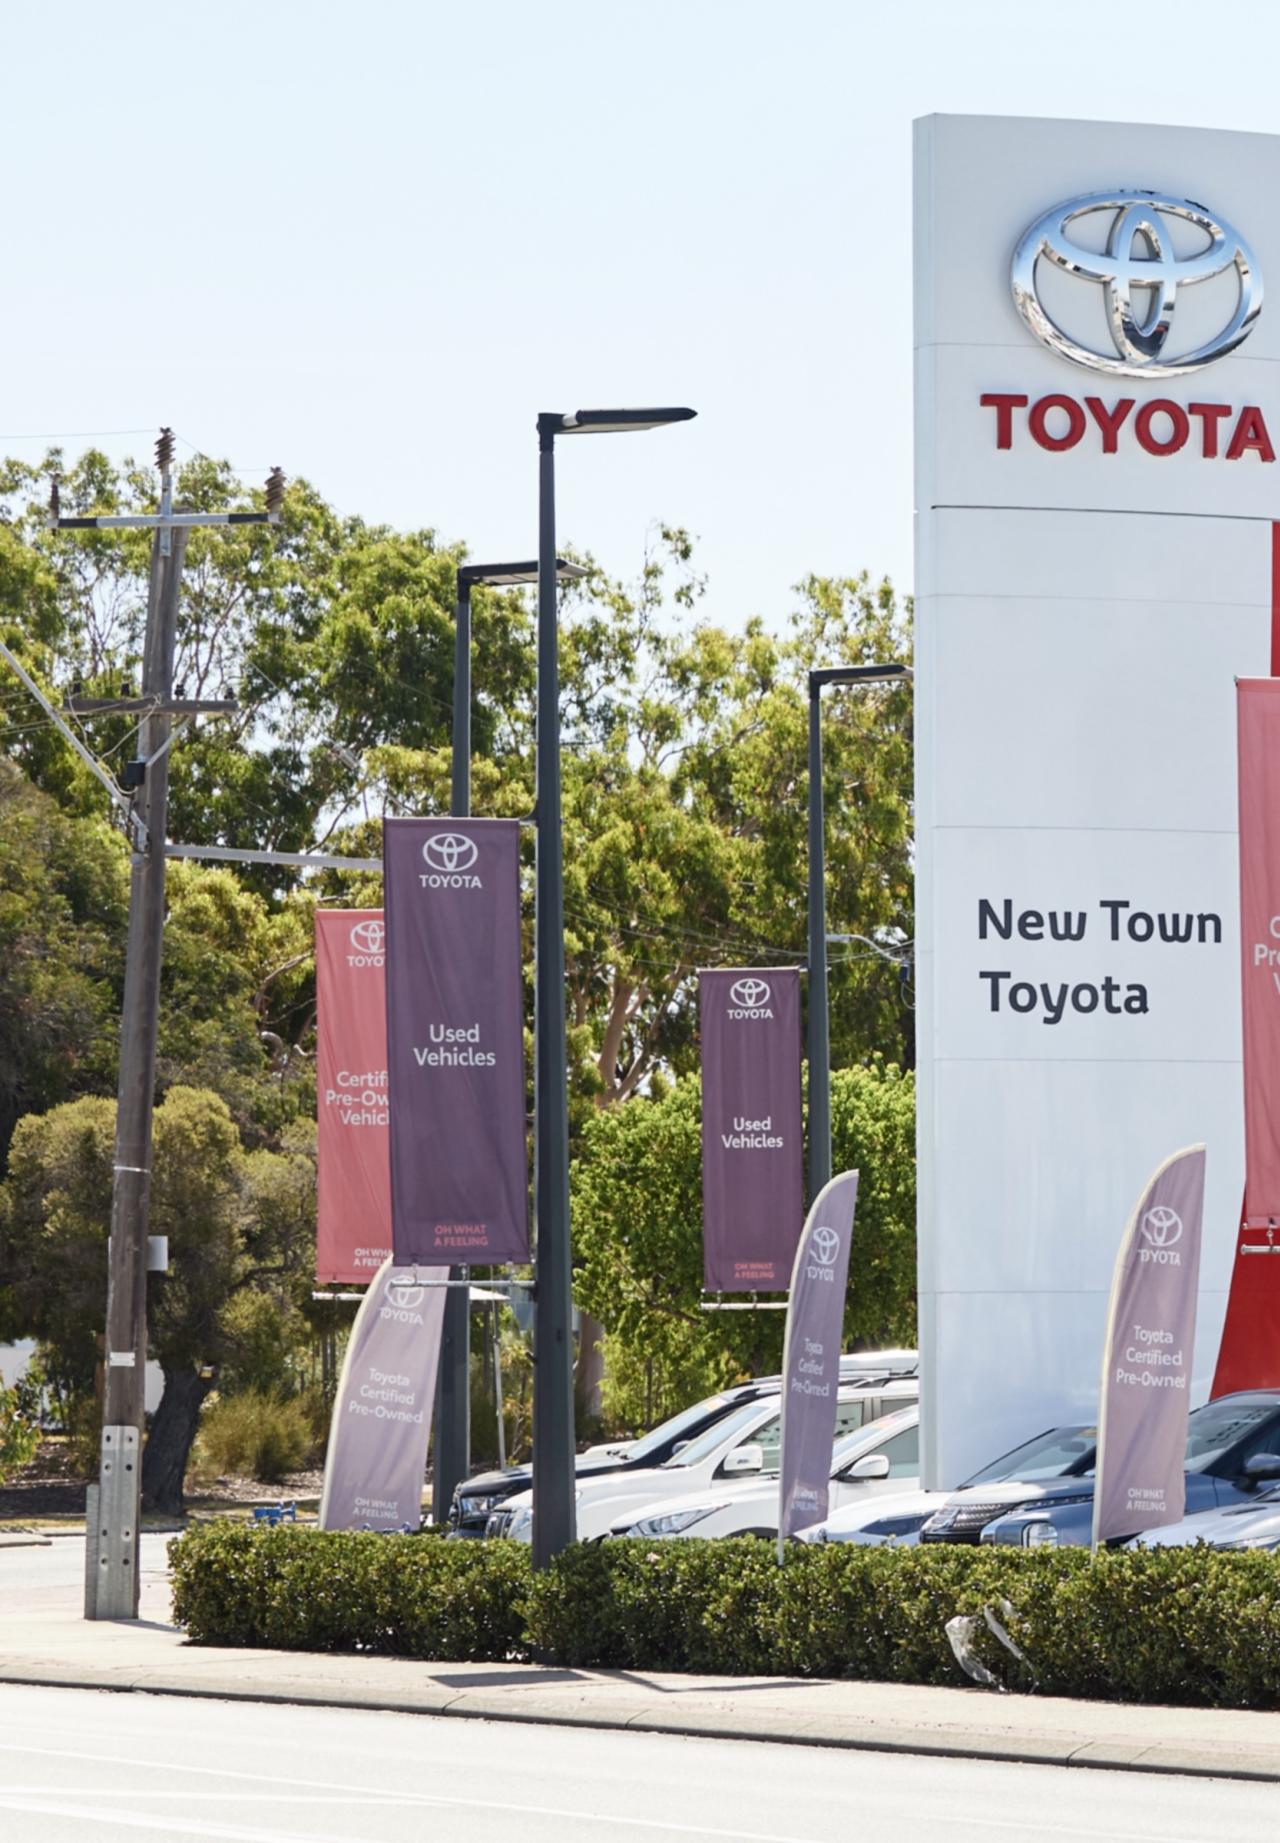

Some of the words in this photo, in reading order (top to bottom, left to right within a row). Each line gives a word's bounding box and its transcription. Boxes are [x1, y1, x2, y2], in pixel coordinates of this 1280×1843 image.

[980, 394, 1276, 463] TOYOTA
[419, 873, 482, 889] TOYOTA
[977, 899, 1087, 942] New
[1100, 900, 1222, 943] Town
[345, 955, 385, 967] TOYO
[979, 971, 1150, 1025] Toyota
[727, 1008, 773, 1020] TOYOTA
[429, 1024, 480, 1044] Used
[413, 1047, 496, 1067] Vehicles
[336, 1071, 388, 1088] Certif
[325, 1089, 389, 1106] Pre-Ow
[339, 1109, 390, 1126] Vehicl
[733, 1116, 771, 1131] Used
[721, 1133, 783, 1149] Vehicles
[434, 1225, 452, 1236] OH
[454, 1224, 487, 1236] WHAT
[434, 1236, 443, 1247] A
[445, 1236, 489, 1247] FEELING
[1133, 1325, 1174, 1344] Toyota
[1126, 1346, 1183, 1366] Certified
[368, 1367, 410, 1387] Toyota
[1116, 1367, 1186, 1389] Pre-Owned
[359, 1384, 416, 1406] Certified
[348, 1400, 424, 1425] Pre-Owned
[1128, 1488, 1142, 1498] OH
[354, 1496, 368, 1508] OH
[369, 1498, 398, 1510] WHAT
[361, 1507, 399, 1520] FEELING
